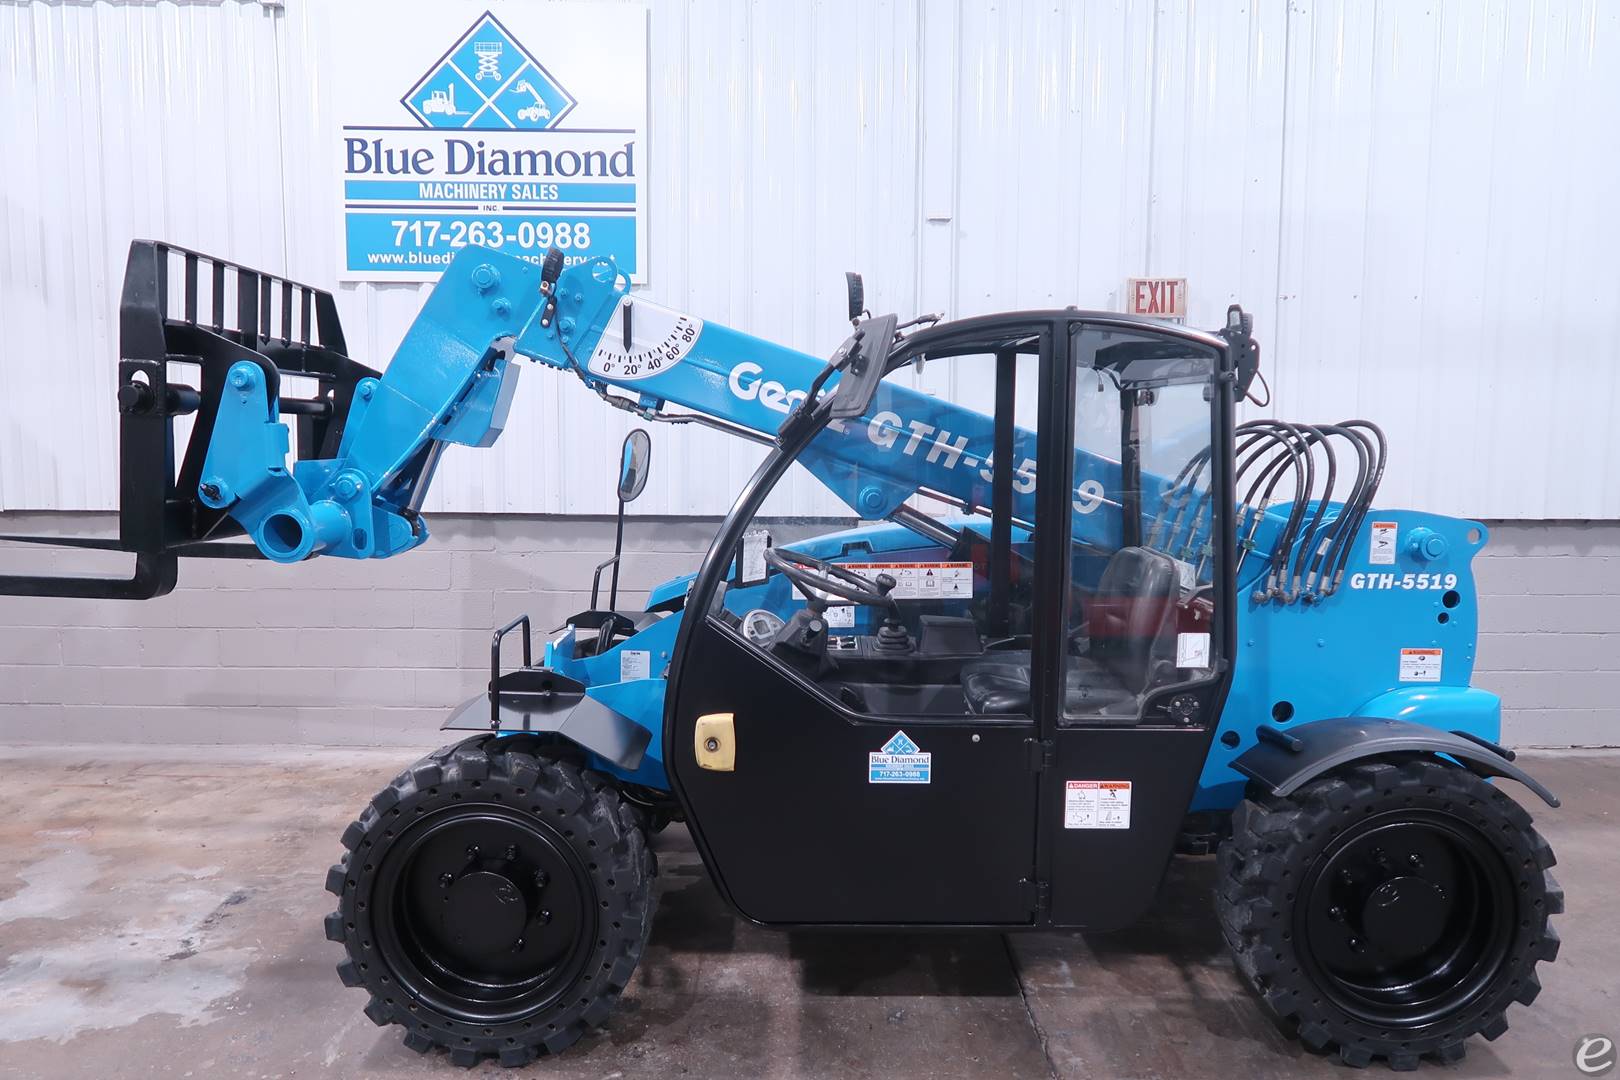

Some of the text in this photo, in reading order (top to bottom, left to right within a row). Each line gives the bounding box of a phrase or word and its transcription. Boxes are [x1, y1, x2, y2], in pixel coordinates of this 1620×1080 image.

[344, 138, 635, 177] Blue Diamond
[419, 183, 559, 200] MACHINERY SALES
[482, 204, 500, 212] INC.
[392, 220, 591, 249] 717-263-0988
[1135, 281, 1178, 313] EXIT
[1350, 573, 1458, 590] GTH-5519
